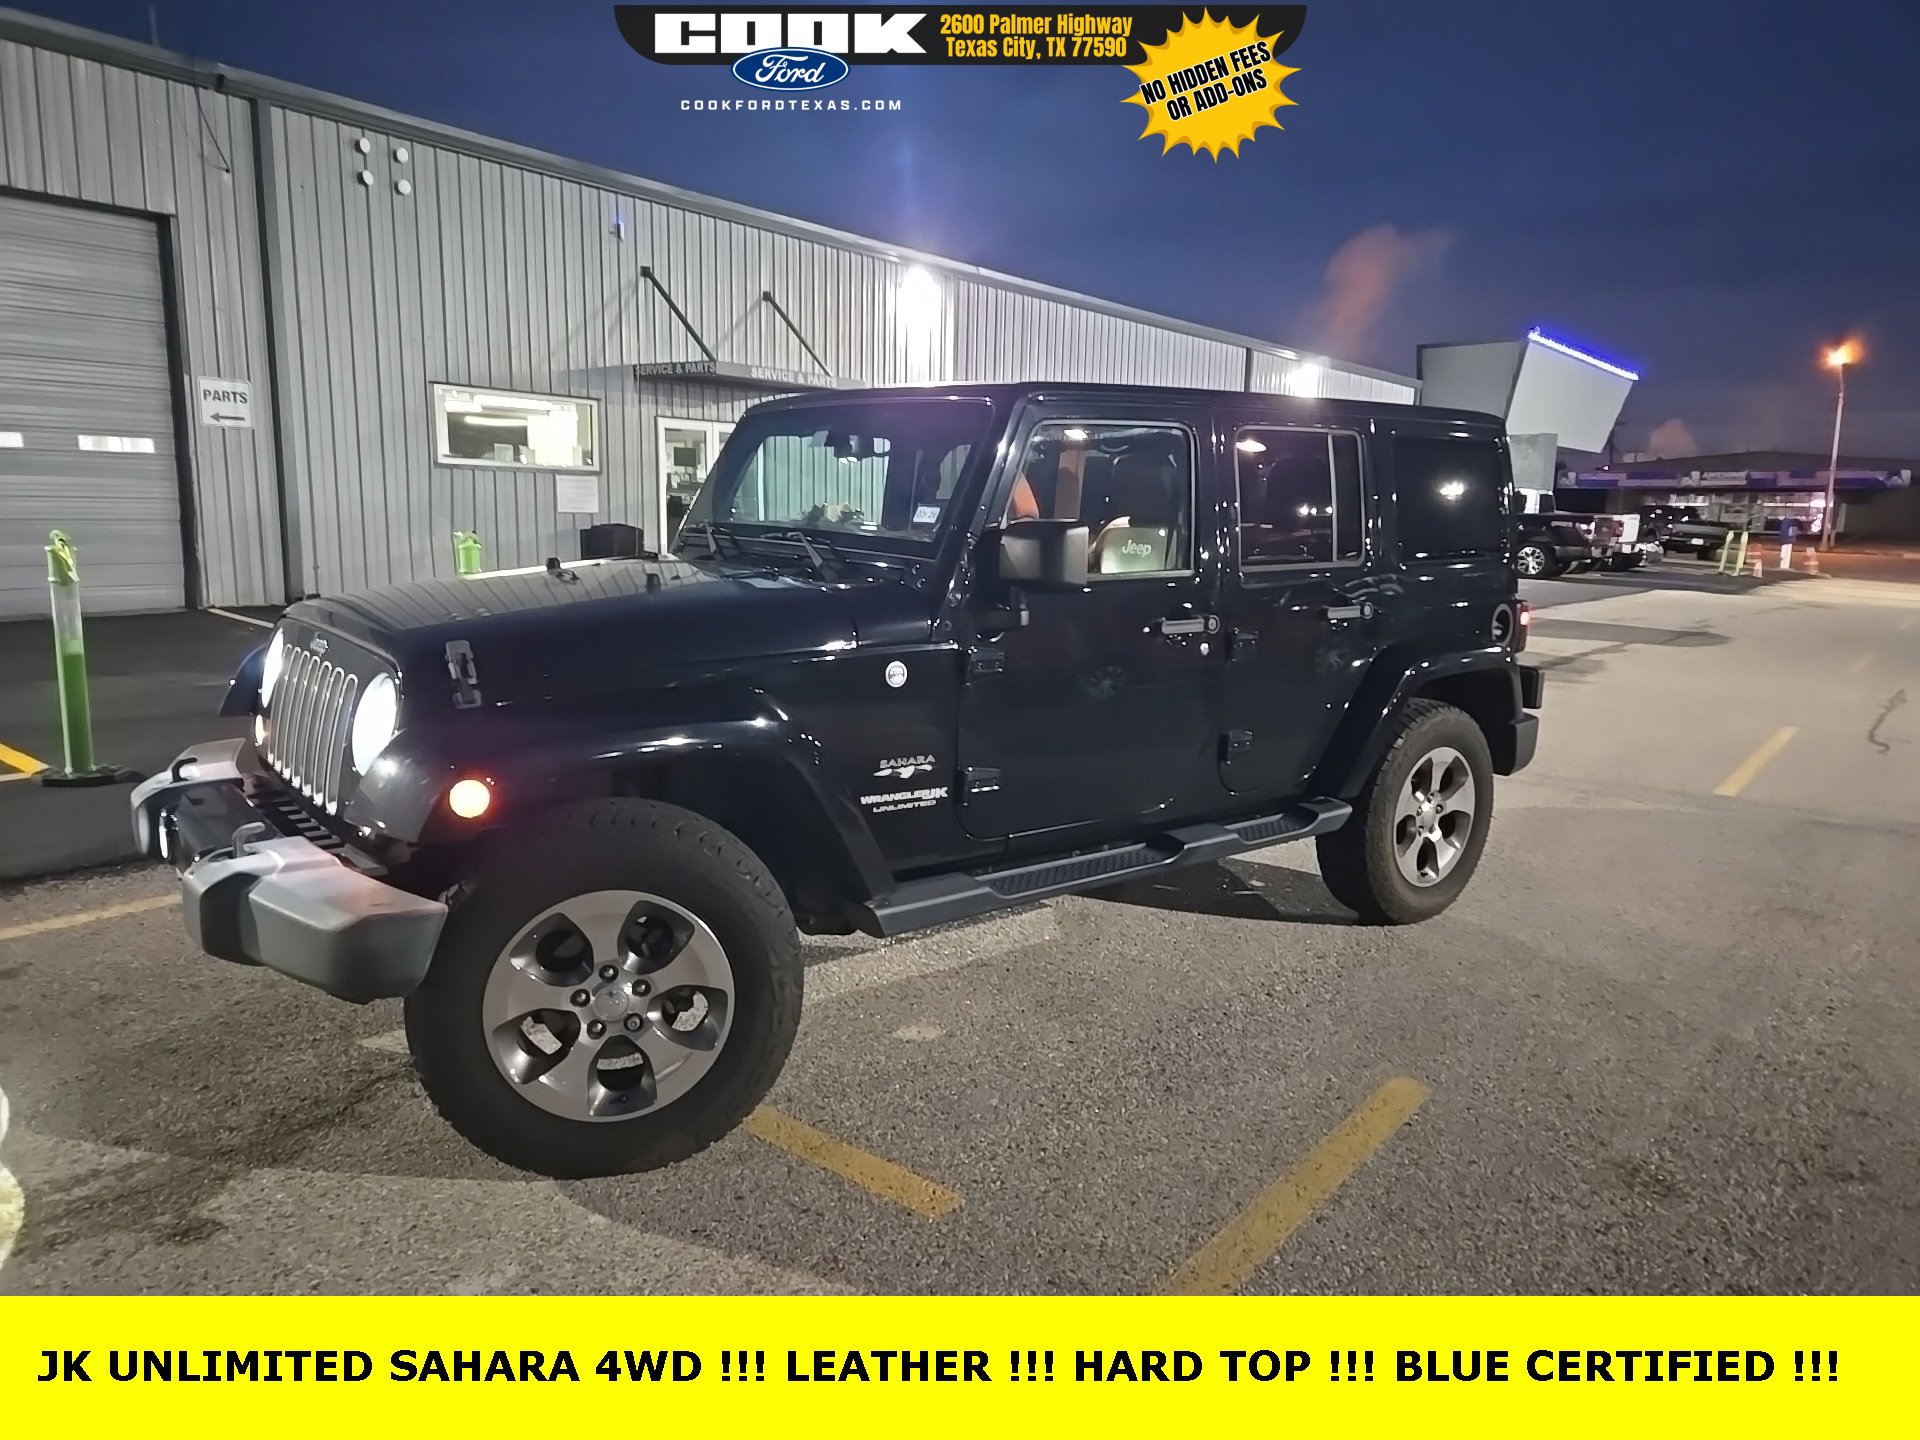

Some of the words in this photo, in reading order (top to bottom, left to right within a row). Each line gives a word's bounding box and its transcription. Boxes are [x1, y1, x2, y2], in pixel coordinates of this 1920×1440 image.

[635, 364, 674, 376] SERVICE
[676, 363, 683, 374] &
[685, 363, 716, 374] PARTS
[750, 367, 795, 383] SERVICE
[796, 375, 804, 384] &
[807, 374, 838, 388] PARTS
[202, 389, 248, 404] PARTS
[1122, 539, 1152, 558] Jeep
[879, 754, 936, 768] SAHARA
[873, 800, 936, 813] UNLIMITED
